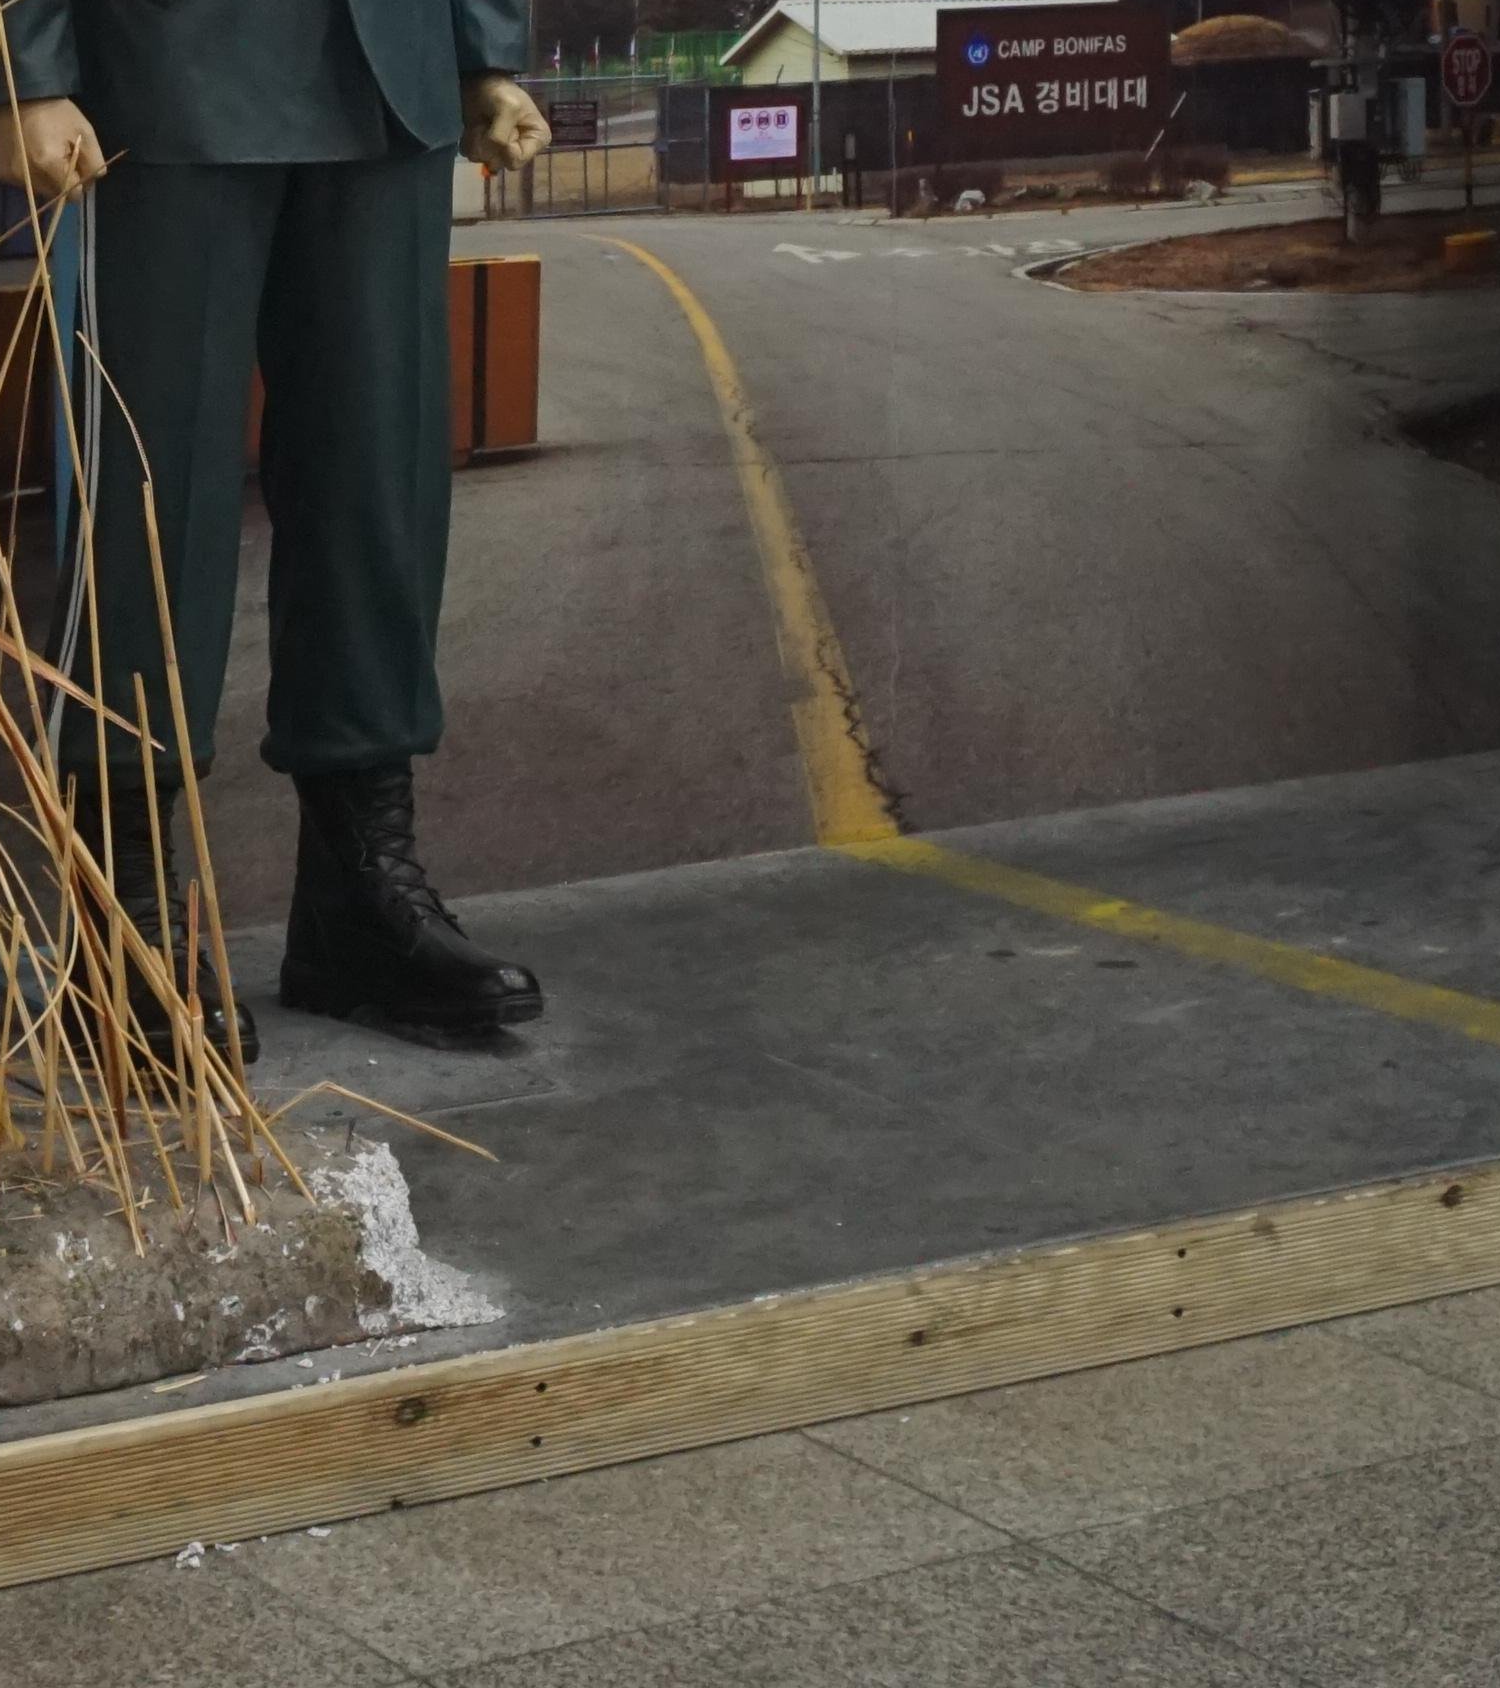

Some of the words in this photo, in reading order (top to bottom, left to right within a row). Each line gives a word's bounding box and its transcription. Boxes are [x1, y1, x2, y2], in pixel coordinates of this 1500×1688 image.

[997, 38, 1045, 59] CAMP
[1053, 33, 1128, 56] BONIFAS
[1452, 48, 1480, 75] STOP
[962, 82, 1025, 117] JSA
[1035, 75, 1148, 114] 경비대대
